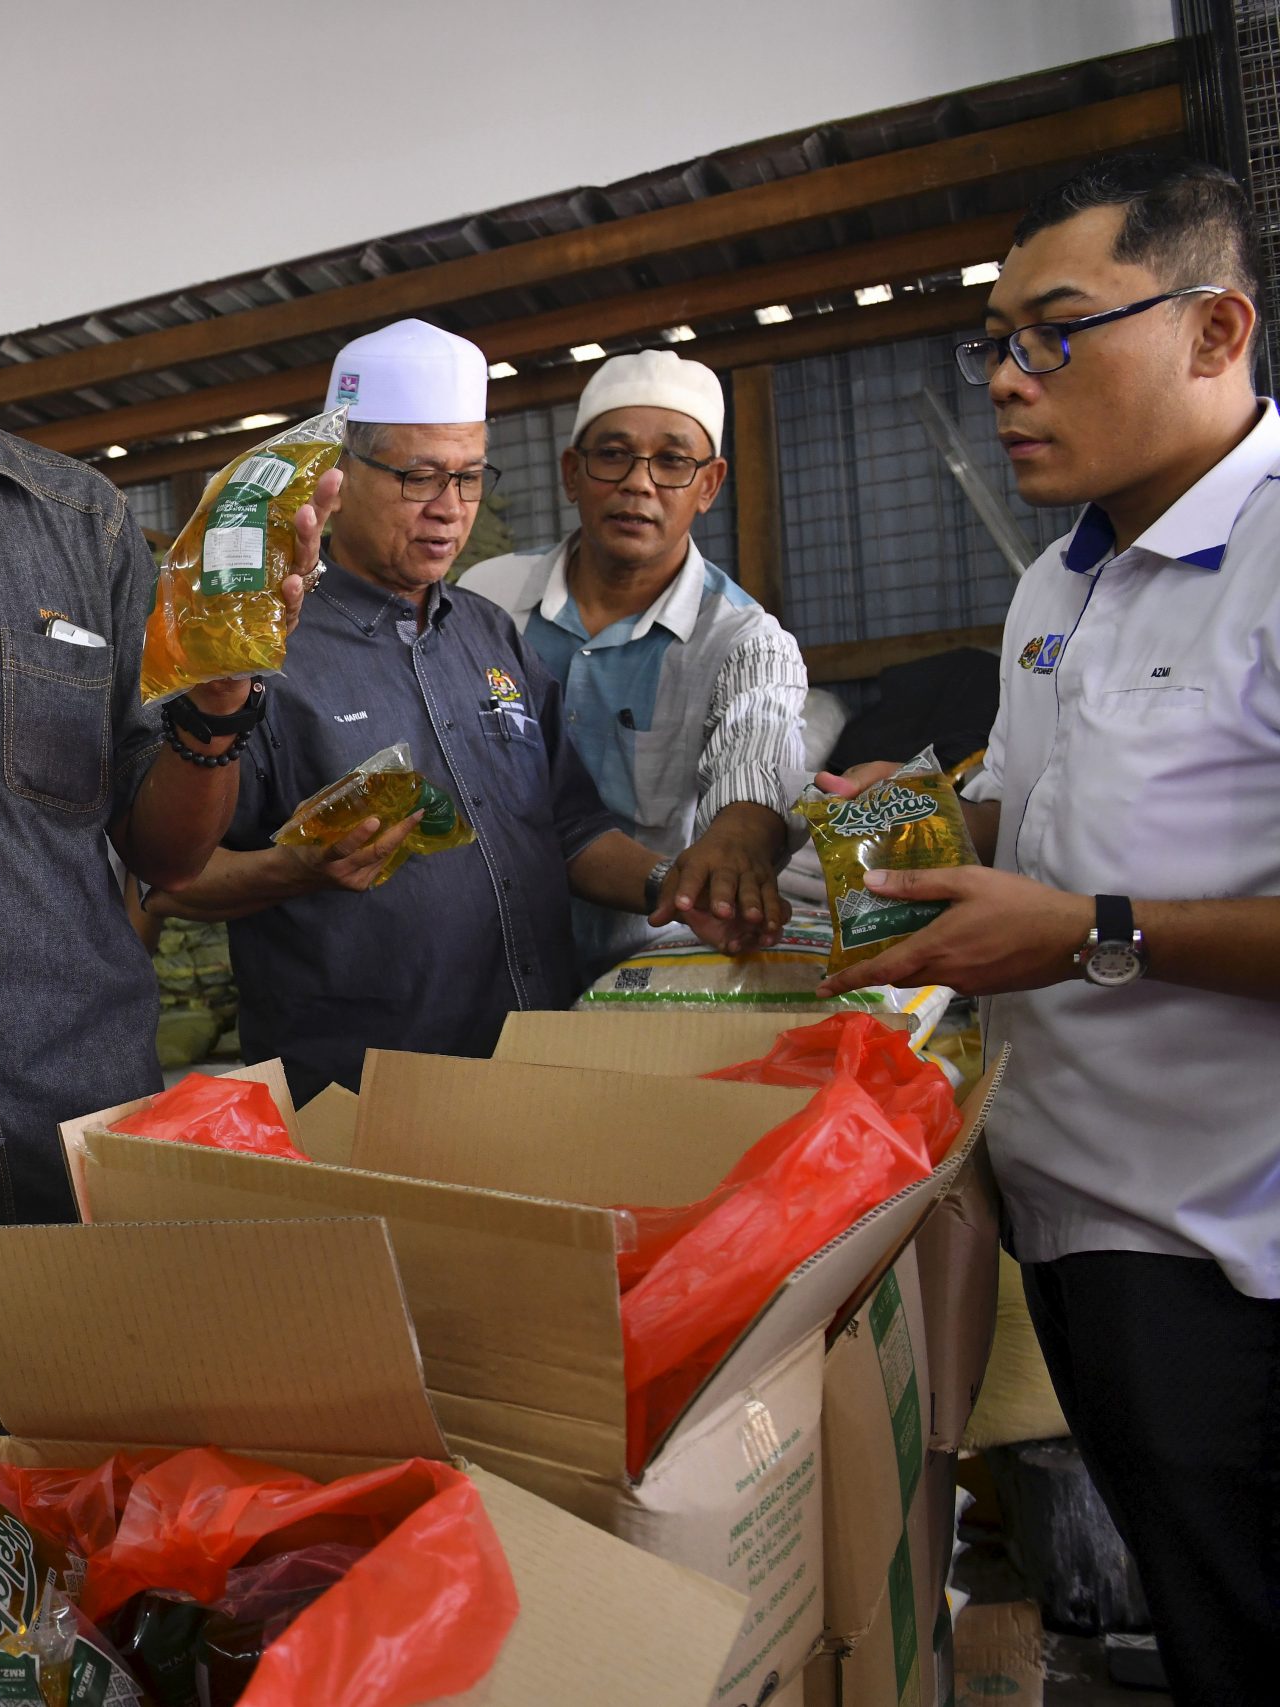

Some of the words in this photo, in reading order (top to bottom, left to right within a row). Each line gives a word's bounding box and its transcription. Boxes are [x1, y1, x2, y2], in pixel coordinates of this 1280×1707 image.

[1151, 667, 1171, 678] AZMI
[344, 711, 368, 722] HARUN
[851, 924, 877, 935] RM2.50
[76, 1661, 94, 1698] RM2.50
